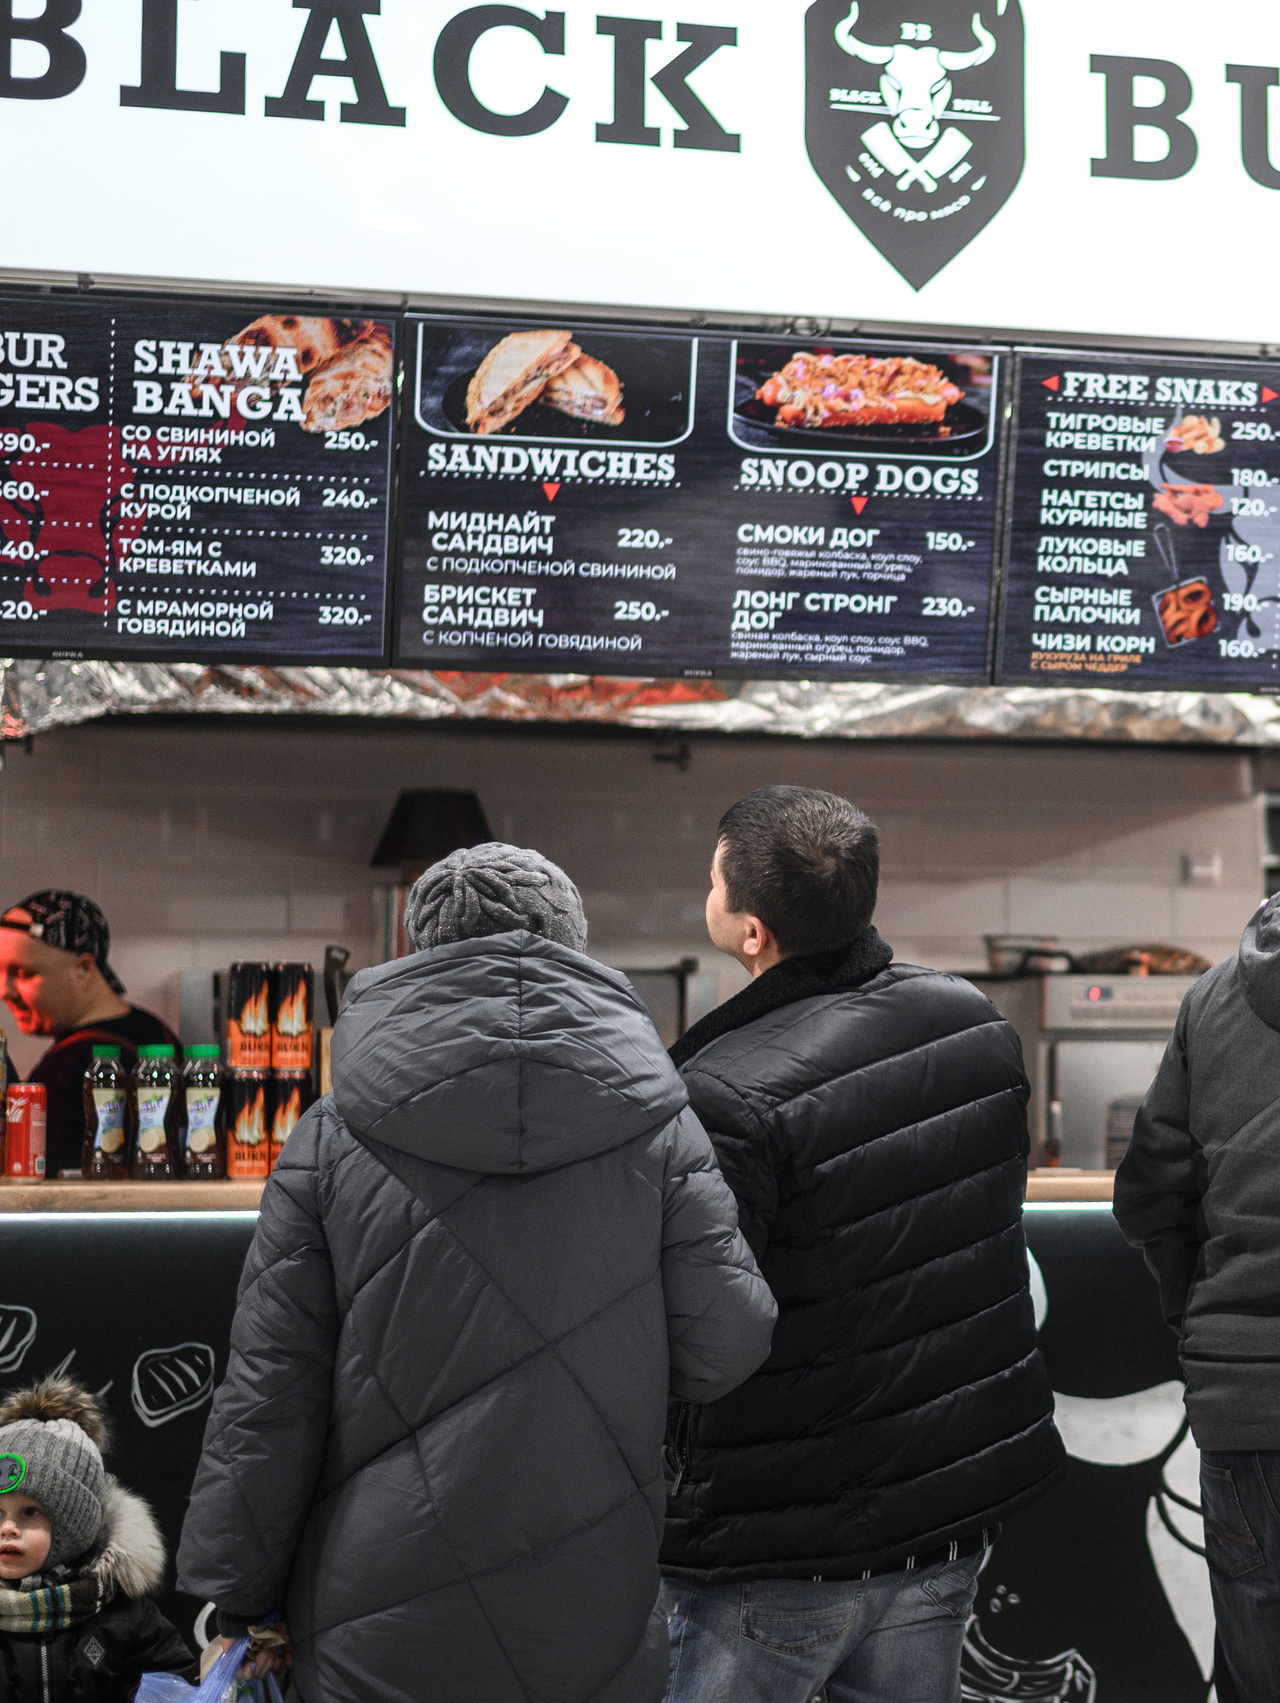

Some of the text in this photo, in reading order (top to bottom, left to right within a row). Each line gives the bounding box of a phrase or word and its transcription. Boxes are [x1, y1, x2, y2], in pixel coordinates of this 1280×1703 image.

[0, 0, 741, 153] BLACK
[952, 98, 993, 113] BULL
[893, 207, 928, 222] про
[134, 340, 303, 381] SHAWA
[1062, 371, 1258, 407] FREE SNAKS
[133, 380, 307, 422] BANGA
[1046, 411, 1166, 435] ТИГРОВЫЕ
[121, 425, 276, 449] СО СВИНИНОЙ
[1045, 431, 1157, 453] КРЕВЕТКИ
[121, 444, 223, 464] НА УГЛЯХ
[427, 442, 677, 482] SANDWICHES
[740, 458, 980, 496] SNOOP DOGS
[1043, 459, 1150, 482] СТРИПСЫ
[120, 482, 301, 507] С ПОДКОПЧЕНОЙ
[1041, 489, 1145, 510] НАГЕТСЫ
[120, 500, 191, 521] КУРОЙ
[1040, 508, 1147, 529] КУРИНЫЕ
[427, 510, 556, 534] МИДНАЙТ
[431, 532, 554, 556] САНДВИЧ
[737, 523, 880, 549] СМОКИ ДОГ
[1037, 535, 1146, 558] ЛУКОВЫЕ
[118, 537, 222, 557] ТОМ-ЯМ С
[118, 557, 256, 578] КРЕВЕТКАМИ
[426, 556, 677, 581] С ПОДКОПЧЕНОЙ СВИНИНОЙ
[736, 556, 760, 566] соус
[790, 559, 871, 571] маринованный
[1036, 554, 1129, 577] КОЛЬЦА
[789, 568, 837, 579] жареный
[862, 571, 906, 582] горчица
[423, 584, 537, 607] БРИСКЕТ
[732, 590, 898, 615] ЛОНГ СТРОНГ
[1034, 586, 1132, 606] СЫРНЫЕ
[117, 599, 274, 620] С МРАМОРНОЙ
[422, 606, 544, 629] САНДВИЧ
[1033, 604, 1141, 625] ПАЛОЧКИ
[117, 617, 246, 638] ГОВЯДИНОЙ
[731, 610, 782, 631] ДОГ
[422, 630, 642, 652] С КОПЧЕНОЙ ГОВЯДИНОЙ
[731, 640, 812, 651] маринованный
[824, 635, 848, 645] коул
[878, 637, 901, 647] соус
[1031, 633, 1156, 653] ЧИЗИ КОРН
[731, 650, 780, 661] жареный
[804, 653, 847, 663] сырный
[848, 655, 873, 666] соус
[1031, 651, 1142, 664] КУКУРУЗА НА ГРИЛЕ
[1040, 660, 1082, 671] СЫРОМ
[1084, 662, 1128, 673] ЧЕДДЕР
